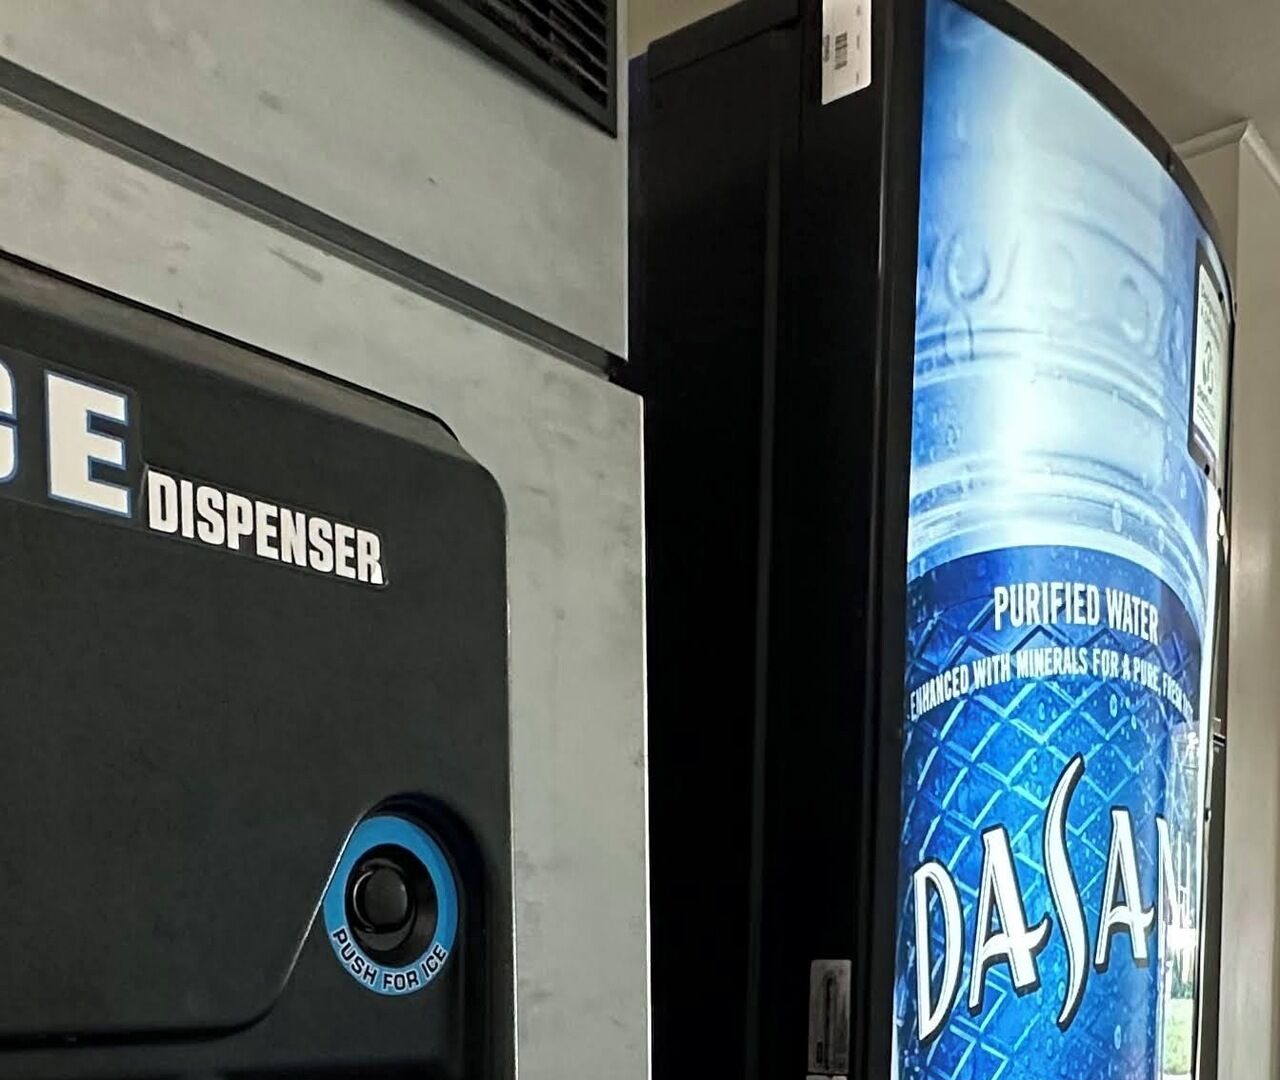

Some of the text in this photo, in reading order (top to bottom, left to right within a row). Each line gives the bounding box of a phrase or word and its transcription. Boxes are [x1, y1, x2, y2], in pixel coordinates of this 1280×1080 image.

[147, 468, 385, 586] DISPENSER
[994, 581, 1160, 646] PURIFIED WATER
[910, 663, 970, 722] ENHANCED
[972, 652, 1011, 690] WITH
[1016, 648, 1089, 680] MINERALS
[1093, 648, 1119, 679] FOR
[1122, 652, 1131, 681] A
[332, 927, 448, 992] PUSH FOR ICE
